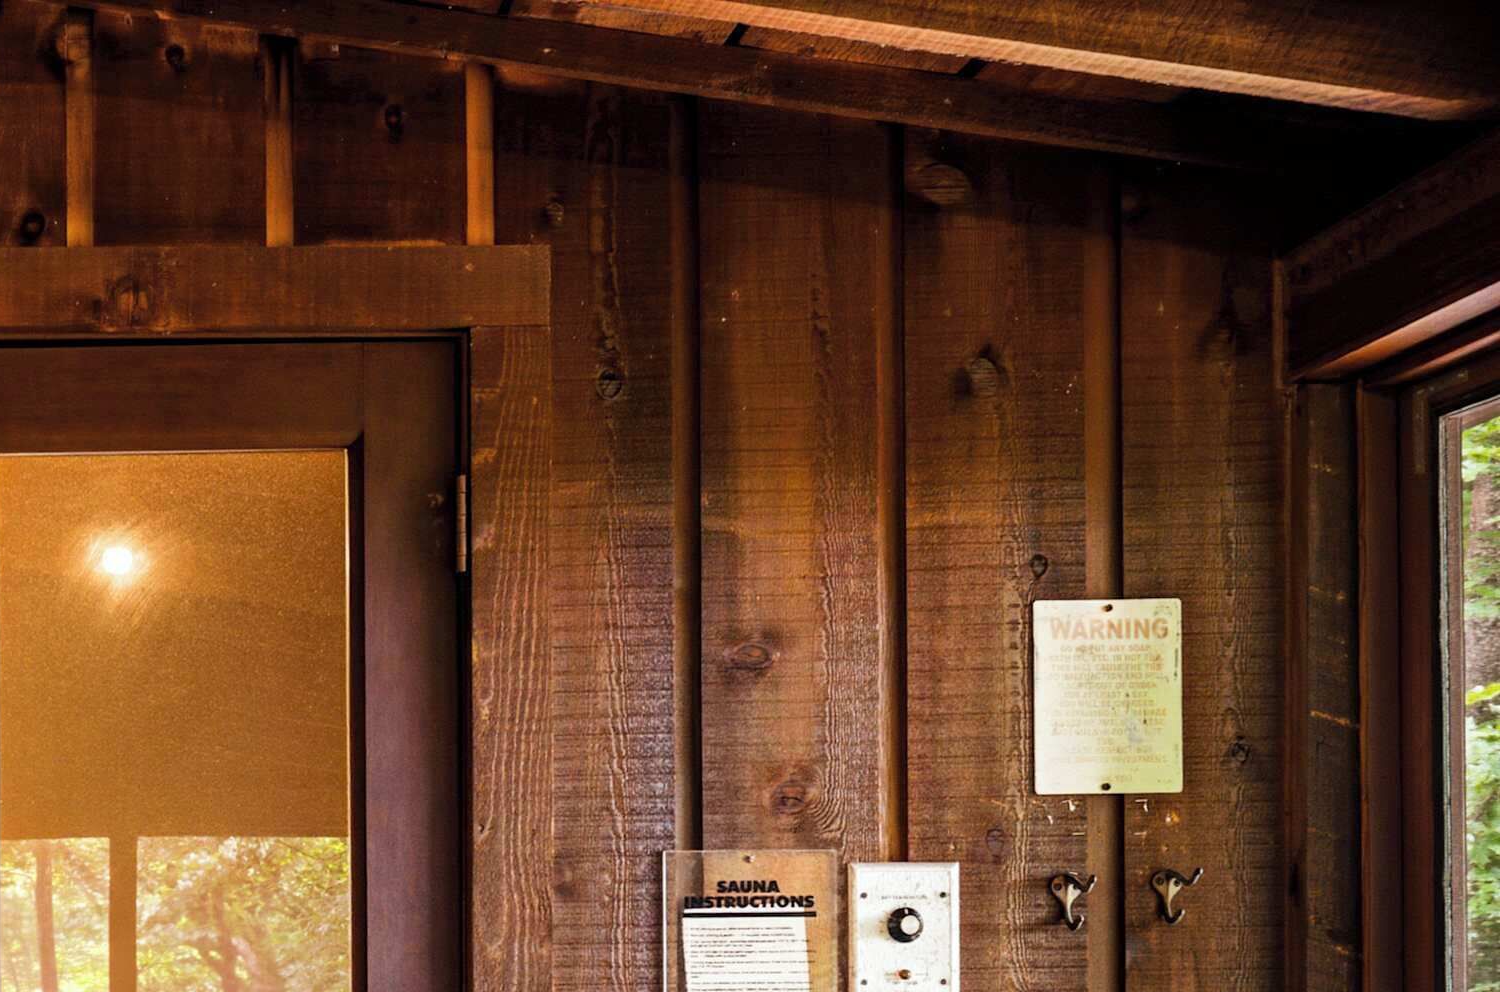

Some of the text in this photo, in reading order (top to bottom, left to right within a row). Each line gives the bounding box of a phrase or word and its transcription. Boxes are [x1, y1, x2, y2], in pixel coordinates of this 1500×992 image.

[1050, 617, 1169, 640] WARNING
[717, 880, 780, 893] SAUNA
[684, 895, 815, 909] INSTRUCTIONS
